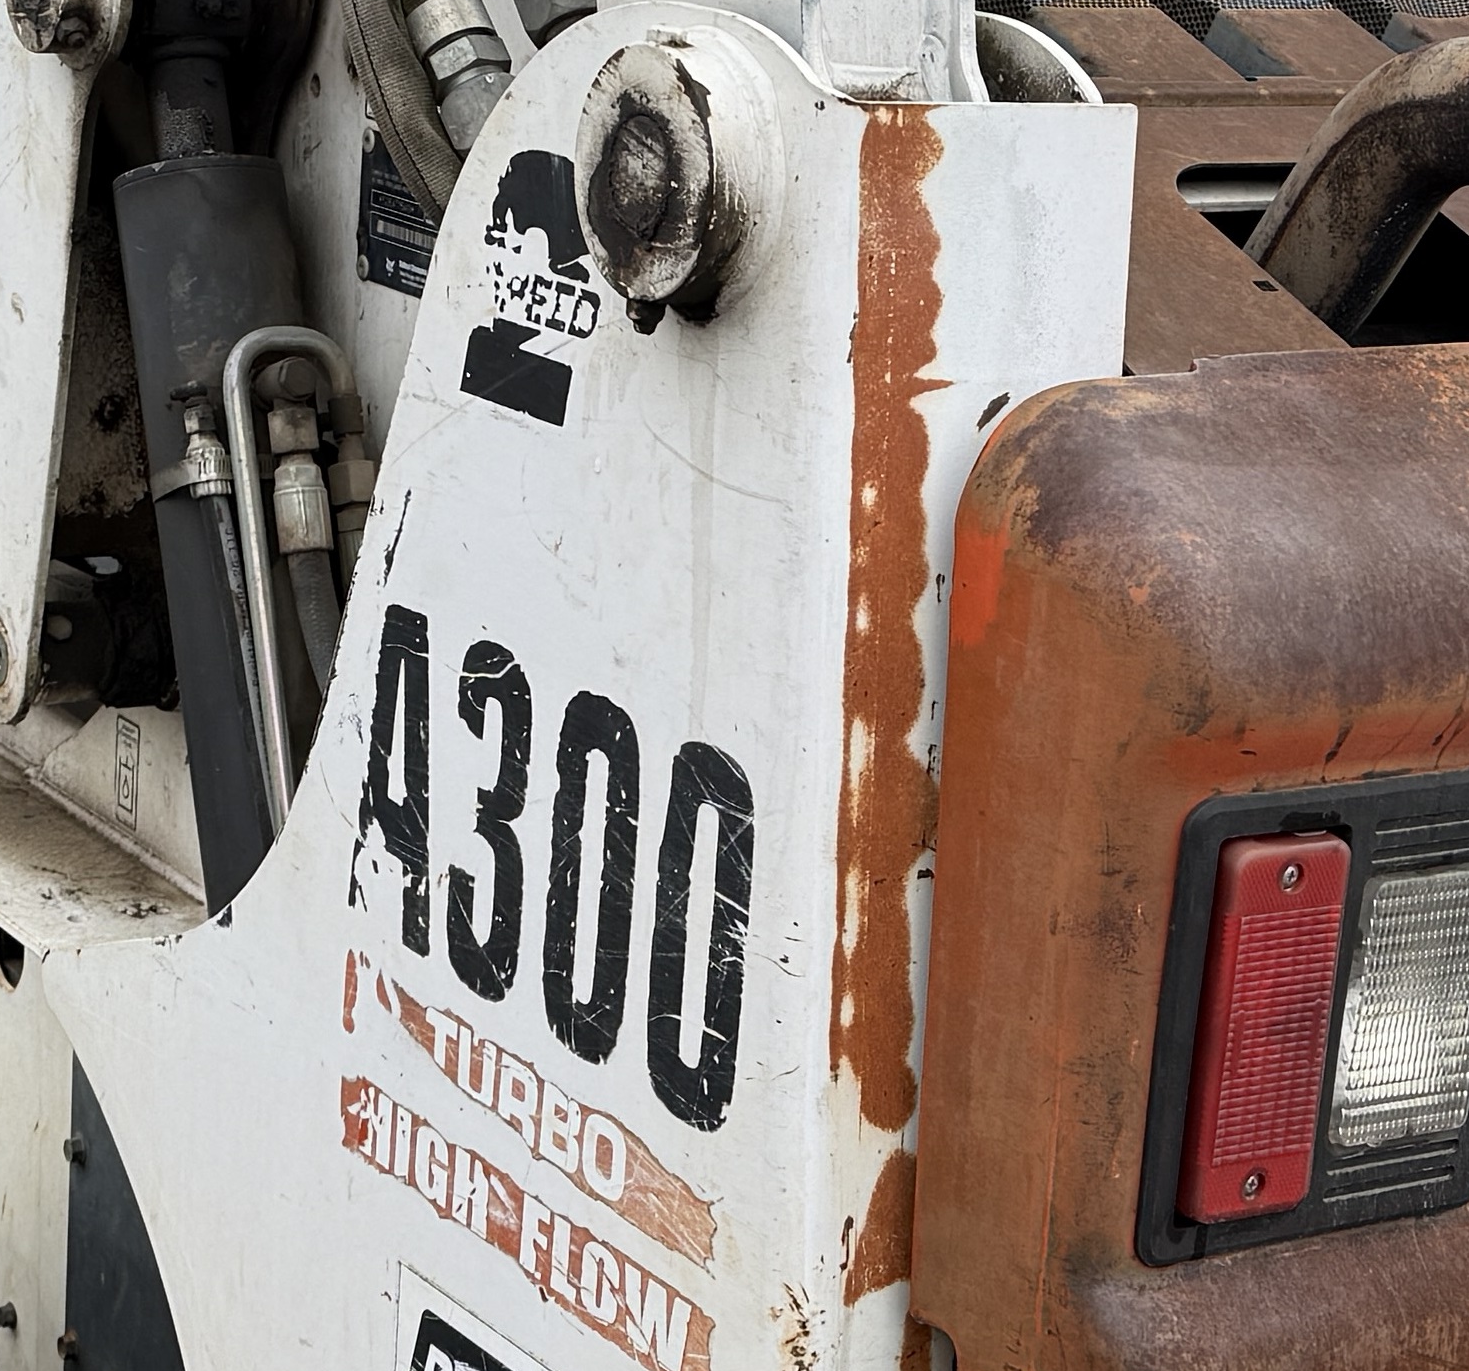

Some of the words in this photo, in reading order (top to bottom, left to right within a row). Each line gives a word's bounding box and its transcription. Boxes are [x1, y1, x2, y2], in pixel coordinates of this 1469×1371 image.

[348, 604, 755, 1132] A300
[359, 1086, 490, 1240] HIGH
[425, 1005, 627, 1202] TURBO
